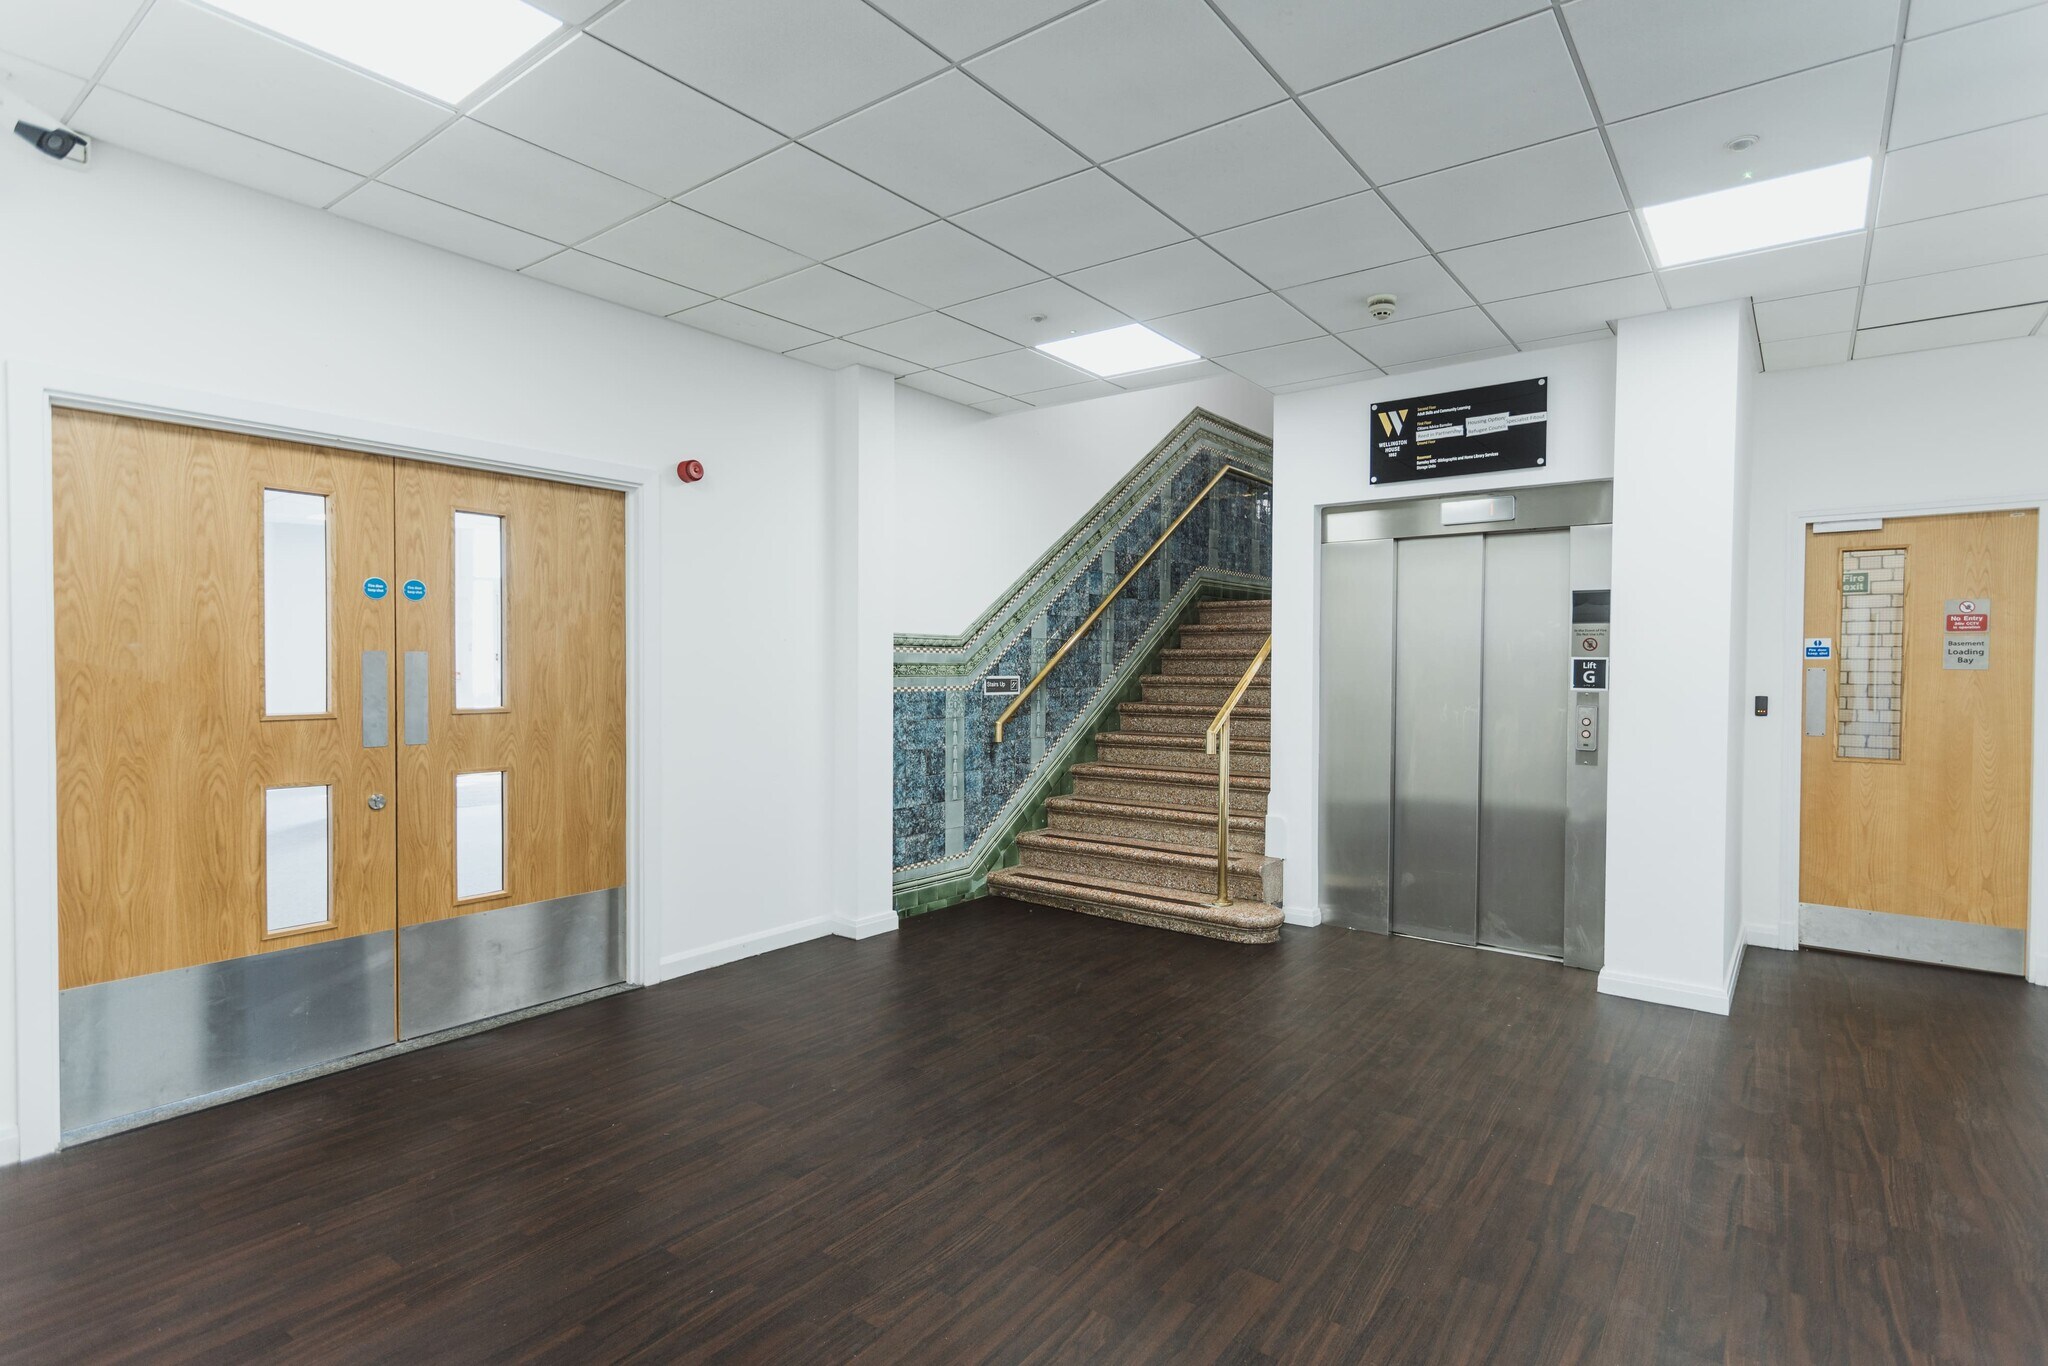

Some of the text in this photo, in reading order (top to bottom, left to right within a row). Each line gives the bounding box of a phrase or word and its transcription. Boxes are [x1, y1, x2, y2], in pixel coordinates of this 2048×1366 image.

[1379, 439, 1408, 447] WELLINGTON
[1842, 574, 1865, 582] Fire
[1842, 583, 1864, 591] exit
[1948, 649, 1985, 657] Loading
[1583, 661, 1597, 669] Lift
[1957, 657, 1974, 665] Bay
[1583, 670, 1596, 684] G
